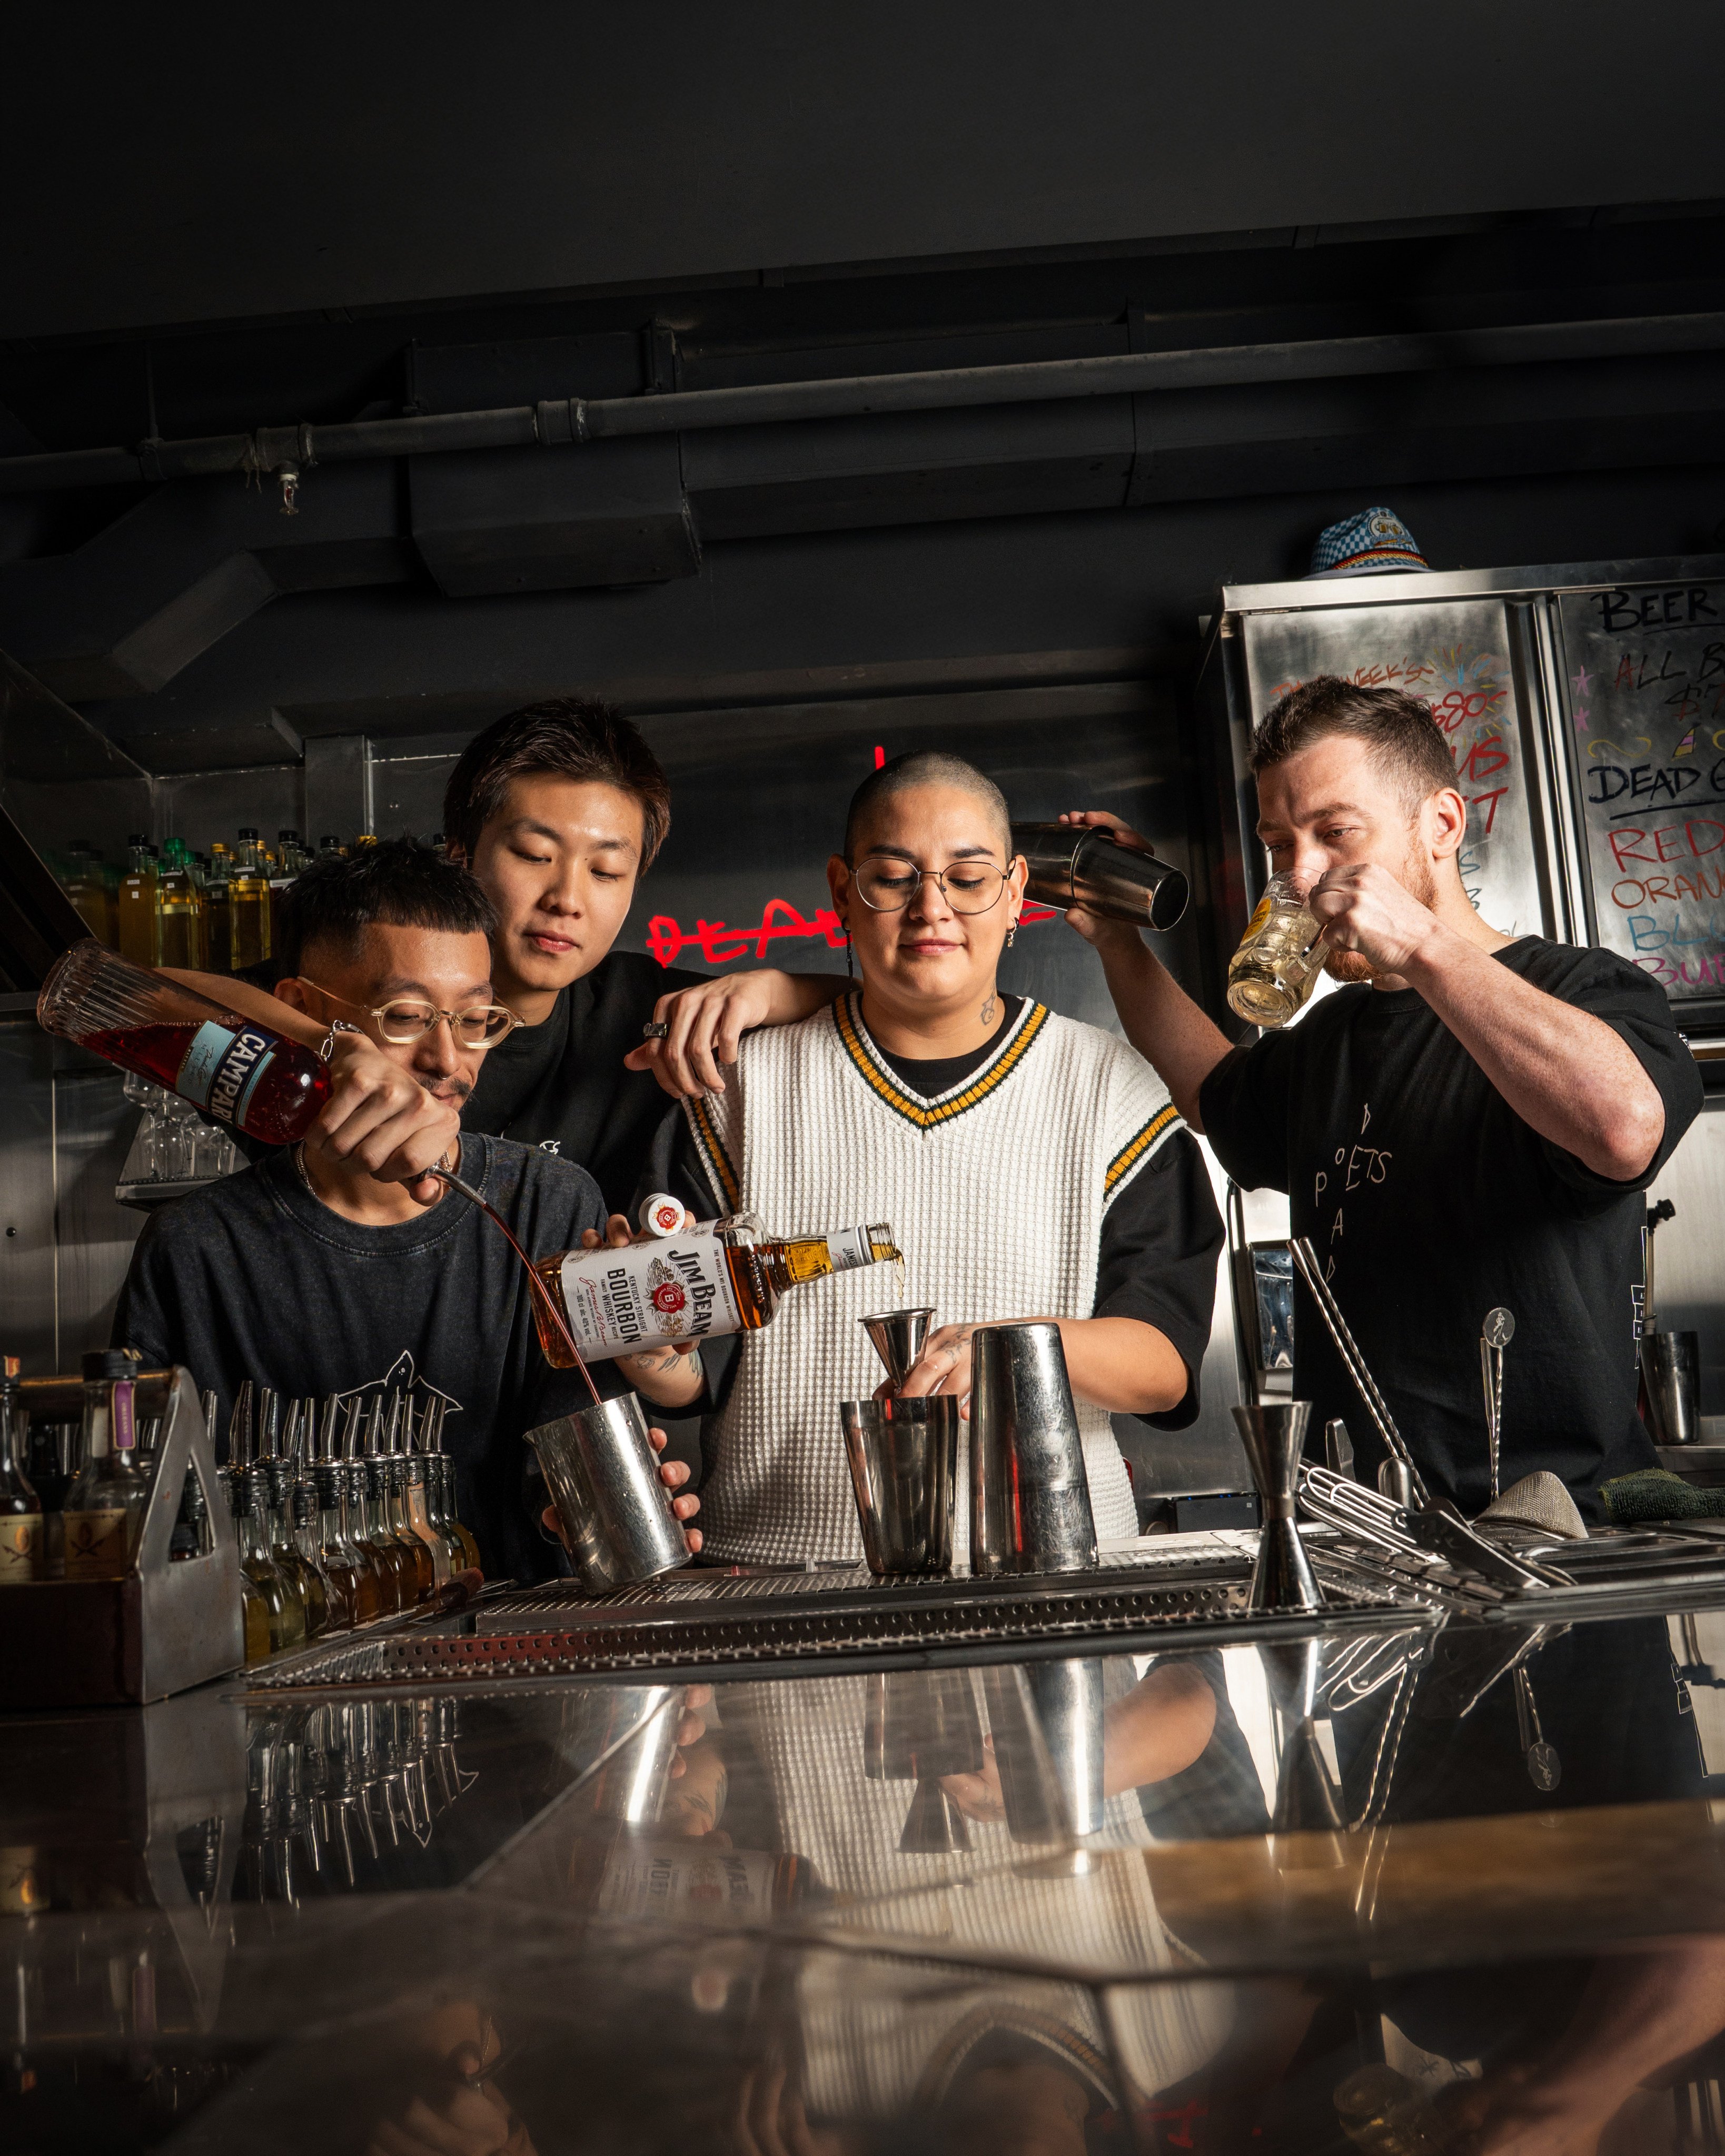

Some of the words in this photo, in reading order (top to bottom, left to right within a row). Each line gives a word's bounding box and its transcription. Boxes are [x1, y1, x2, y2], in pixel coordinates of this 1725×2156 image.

[1590, 588, 1718, 632] BEER
[1615, 650, 1687, 690] ALL
[1588, 764, 1700, 804] DEAD
[1608, 819, 1725, 873] RED
[1611, 866, 1725, 909] ORAN
[842, 1248, 858, 1265] JAMES
[601, 1293, 617, 1327] WHISKEY
[606, 1267, 641, 1345] BOURBON
[628, 1275, 641, 1305] KENTUCKY
[635, 1305, 648, 1333] STRAIGHT
[715, 1258, 723, 1277] WORLD'S
[721, 1285, 730, 1304] BOURBON
[726, 1305, 735, 1322] WHISKEY
[581, 1317, 590, 1328] 40%
